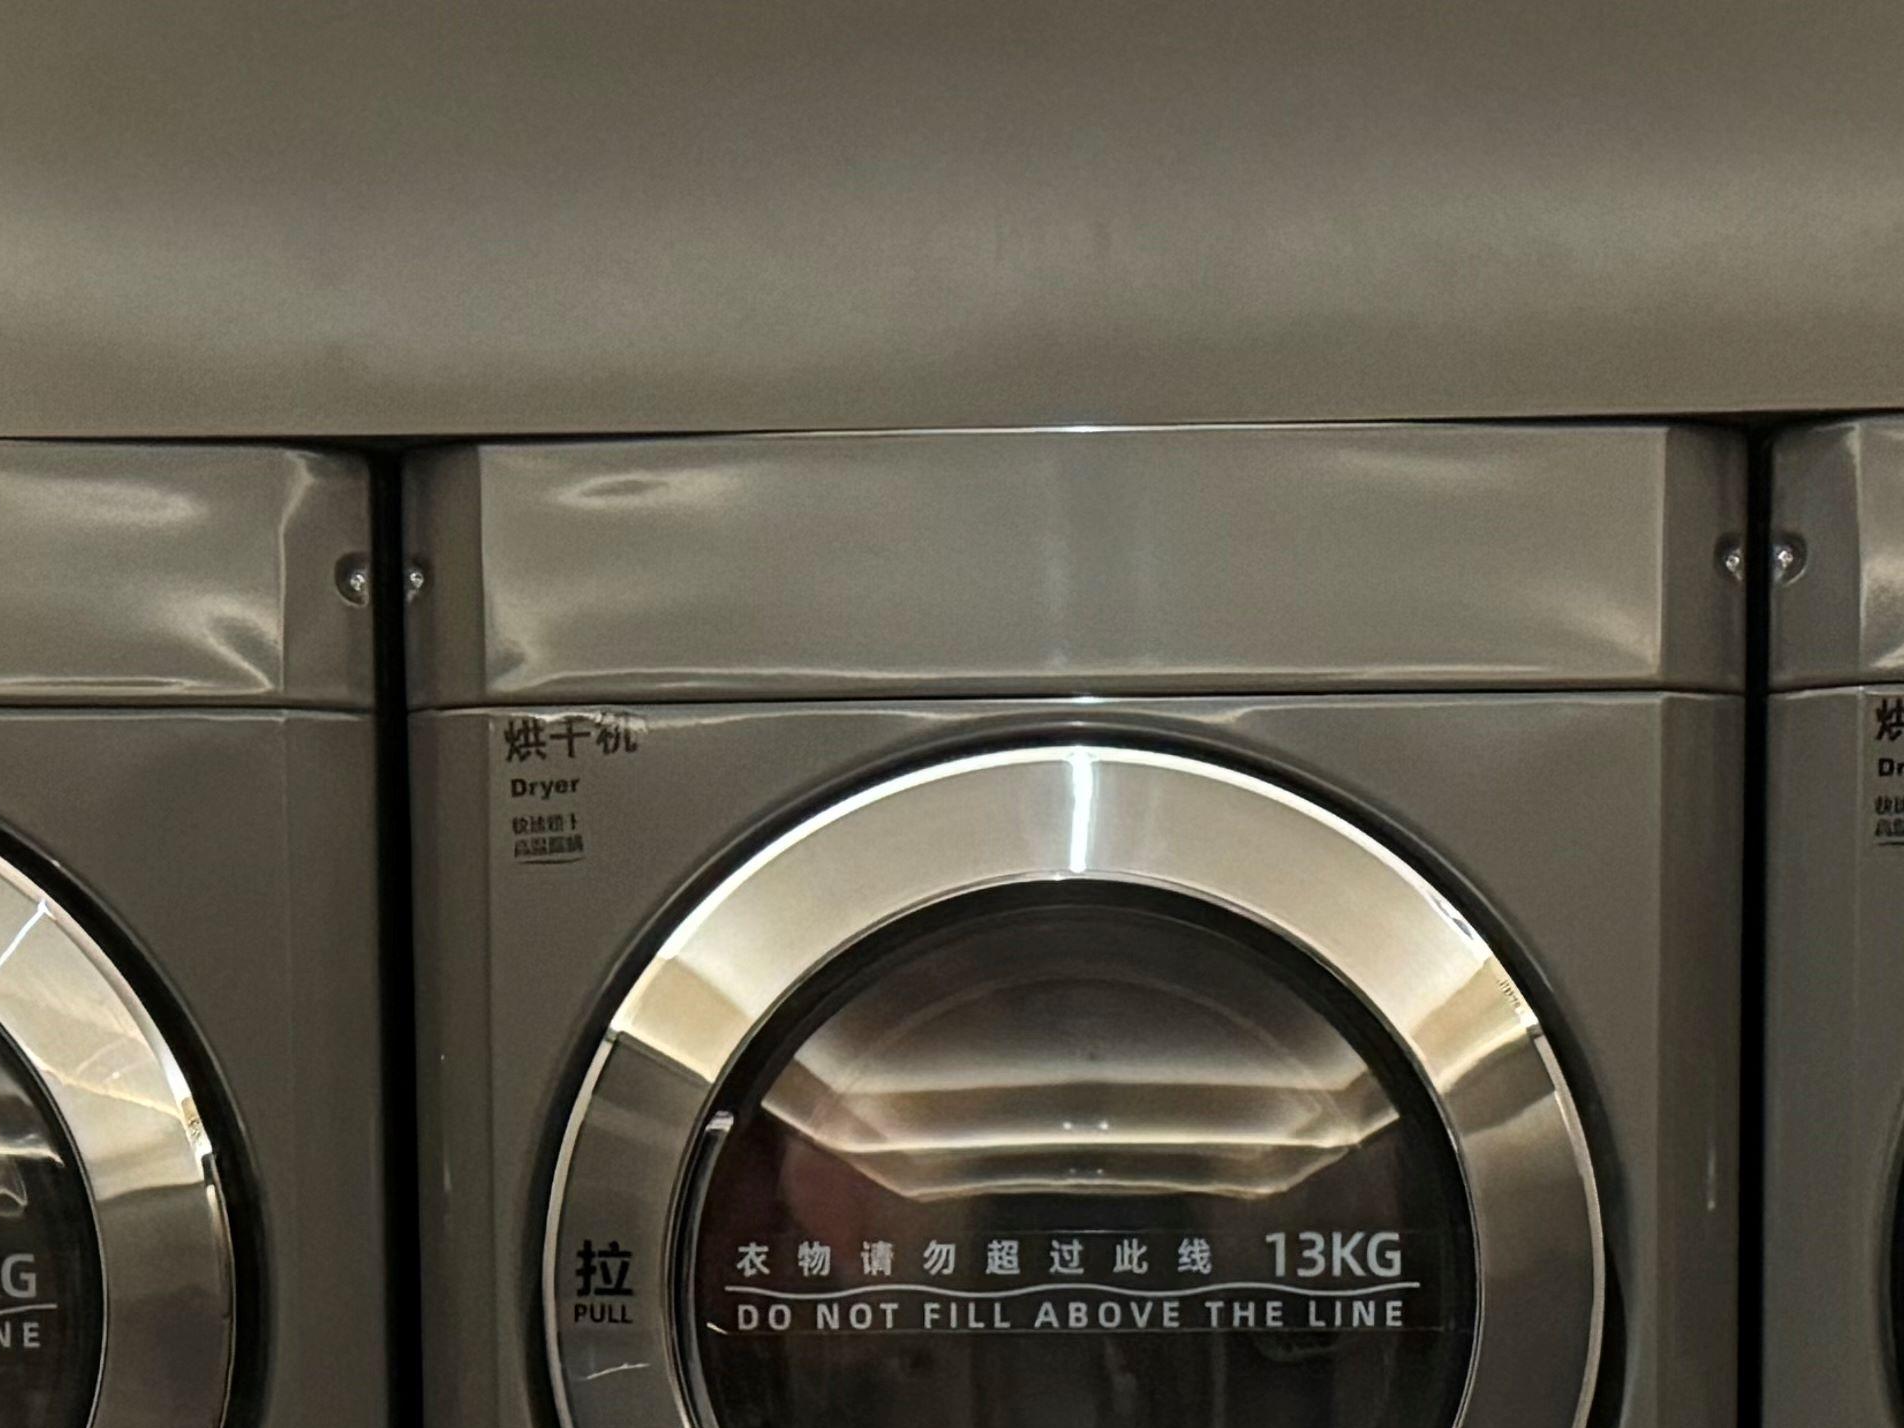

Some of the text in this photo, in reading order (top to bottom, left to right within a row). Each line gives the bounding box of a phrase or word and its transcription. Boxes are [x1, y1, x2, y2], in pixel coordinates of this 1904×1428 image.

[504, 716, 639, 762] 烘干机
[511, 777, 580, 800] Dryer
[576, 1240, 633, 1296] 拉
[737, 1232, 1400, 1276] 衣物请勿超过此线 13KG
[575, 1304, 632, 1323] PULL
[739, 1301, 1402, 1330] DO NOT FILL ABOVE THE LINE
